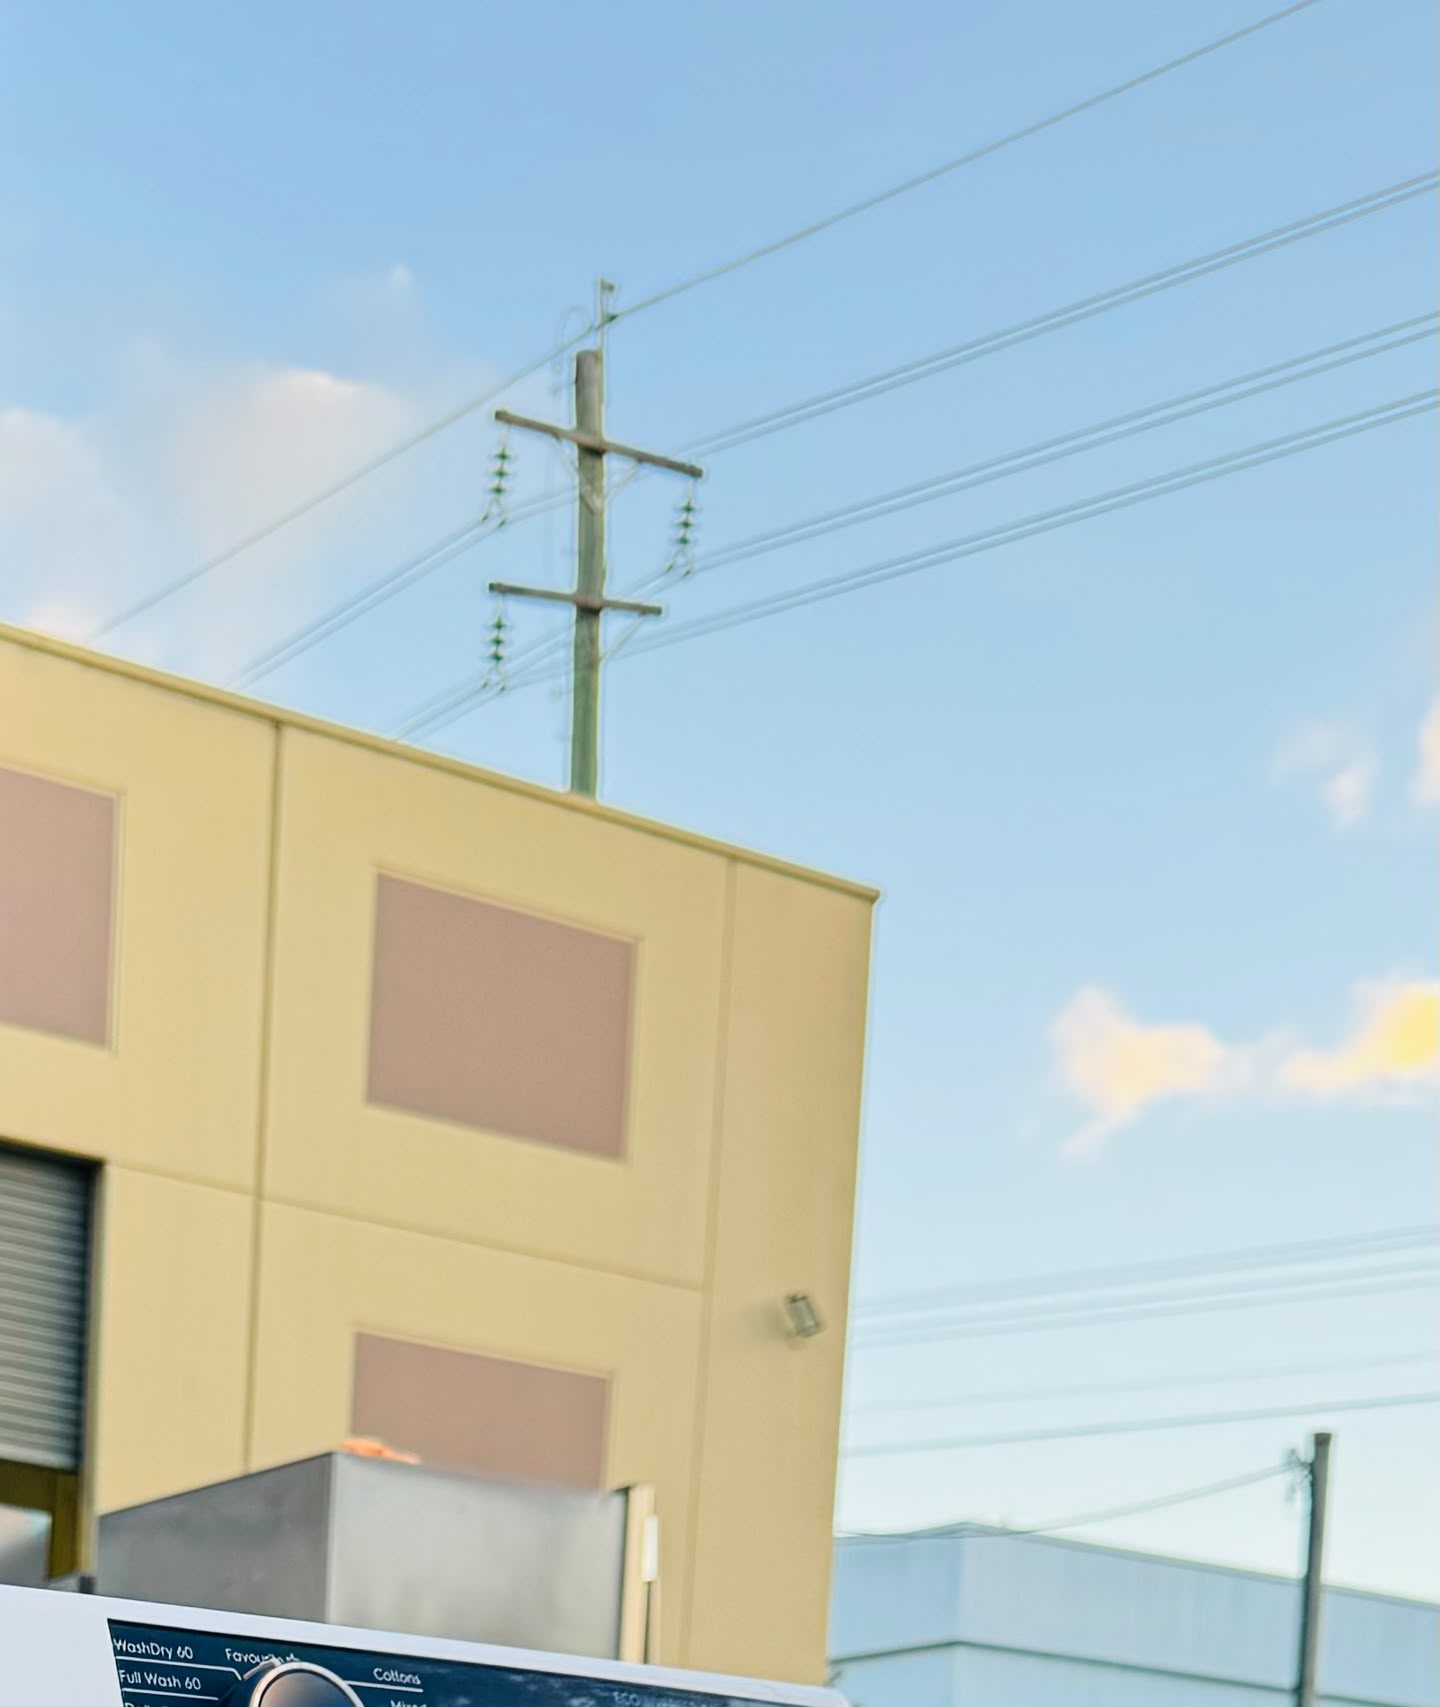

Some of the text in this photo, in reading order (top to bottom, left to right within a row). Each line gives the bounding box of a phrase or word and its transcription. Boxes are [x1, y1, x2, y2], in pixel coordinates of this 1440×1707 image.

[113, 1638, 193, 1659] WashDry 60
[119, 1670, 201, 1690] Full Wash 60
[373, 1667, 421, 1684] Cottons
